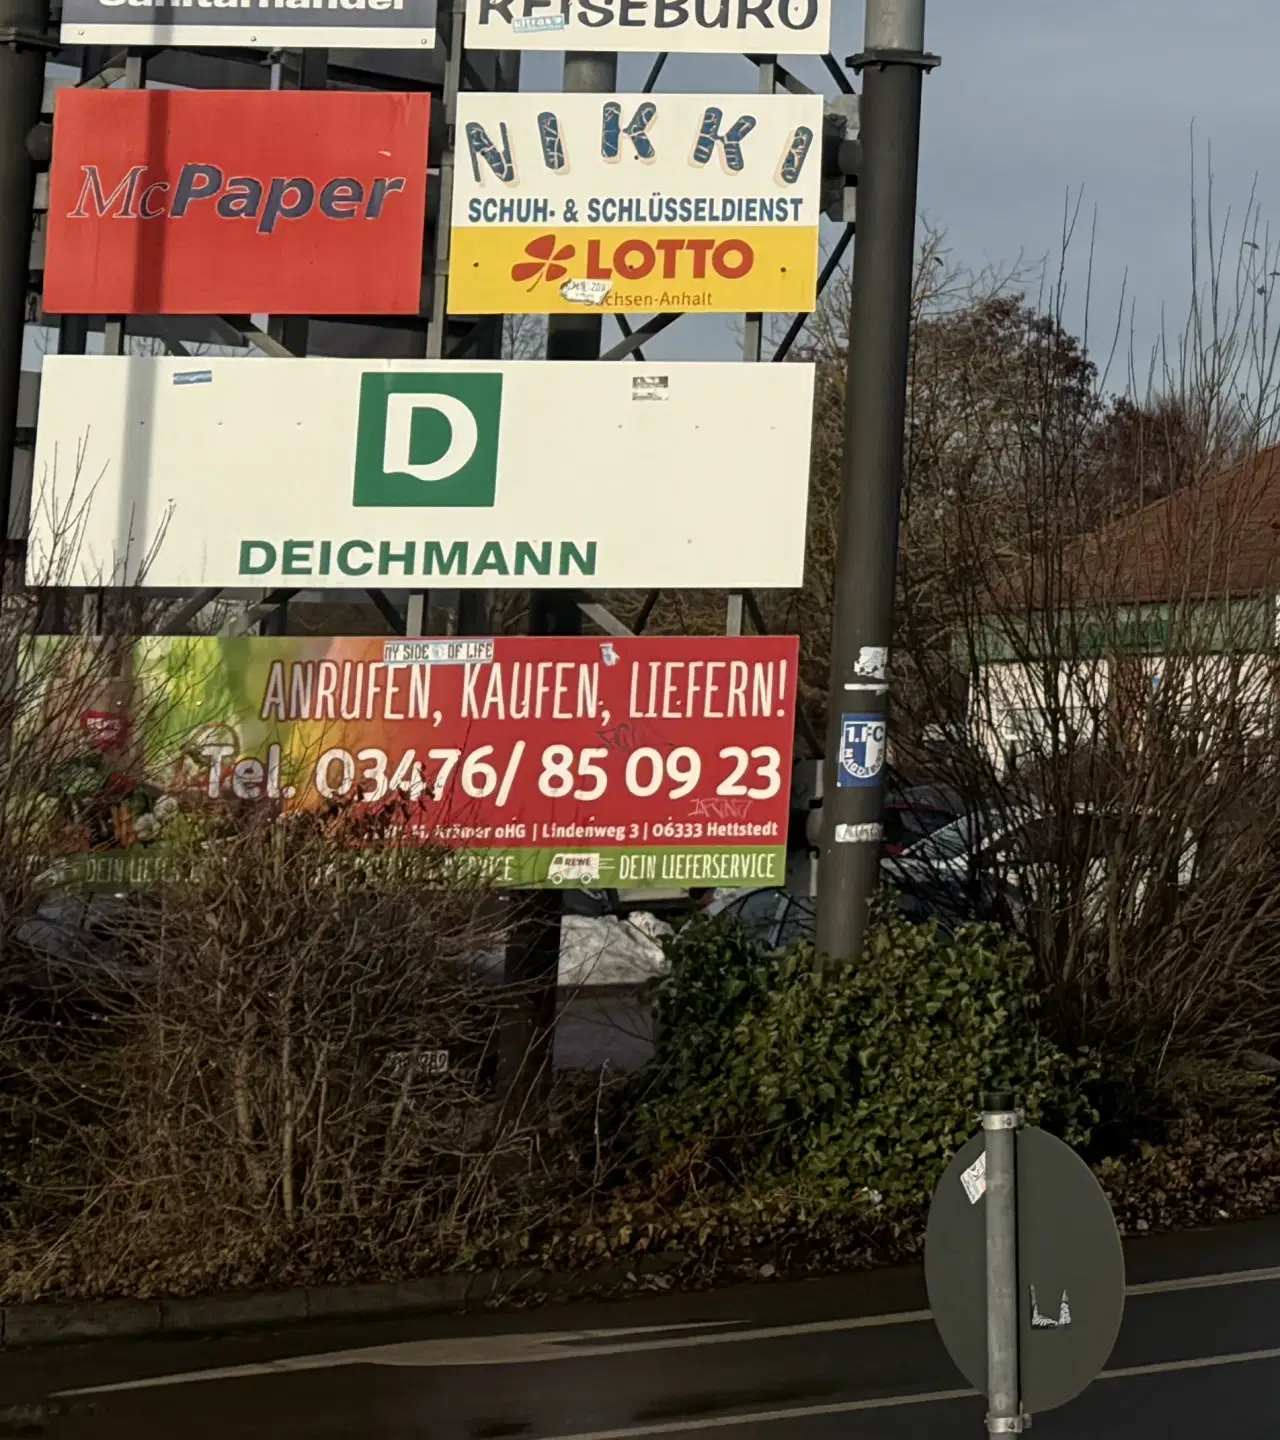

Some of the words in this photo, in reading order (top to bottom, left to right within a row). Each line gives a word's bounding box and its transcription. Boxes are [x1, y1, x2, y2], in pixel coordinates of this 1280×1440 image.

[464, 100, 815, 188] NIKKI
[66, 161, 407, 235] McPaper
[468, 197, 556, 223] SCHUH-
[562, 198, 580, 223] &
[586, 191, 804, 224] SCHLÜSSELDIENST
[585, 237, 756, 280] LOTTO
[584, 291, 713, 308] chsen-Anhalt
[384, 392, 480, 482] D
[238, 539, 598, 577] DEICHMANN
[402, 643, 429, 660] SIDE
[466, 642, 493, 659] LIFE
[260, 660, 443, 728] ANRUFEN,
[461, 661, 611, 727] KAUFEN,
[629, 659, 788, 719] LIEFERN!
[200, 743, 297, 800] Tel.
[315, 740, 526, 807] 03476/
[538, 744, 609, 802] 85
[625, 747, 702, 800] 09
[716, 746, 782, 800] 23
[494, 823, 526, 840] oHG
[542, 822, 626, 841] Lindenweg
[629, 823, 640, 839] 3
[652, 822, 703, 839] 06333
[706, 820, 778, 837] Hettstedt
[564, 857, 592, 867] REWE
[619, 853, 657, 880] DEIN
[662, 853, 776, 879] LIEFERSERVICE
